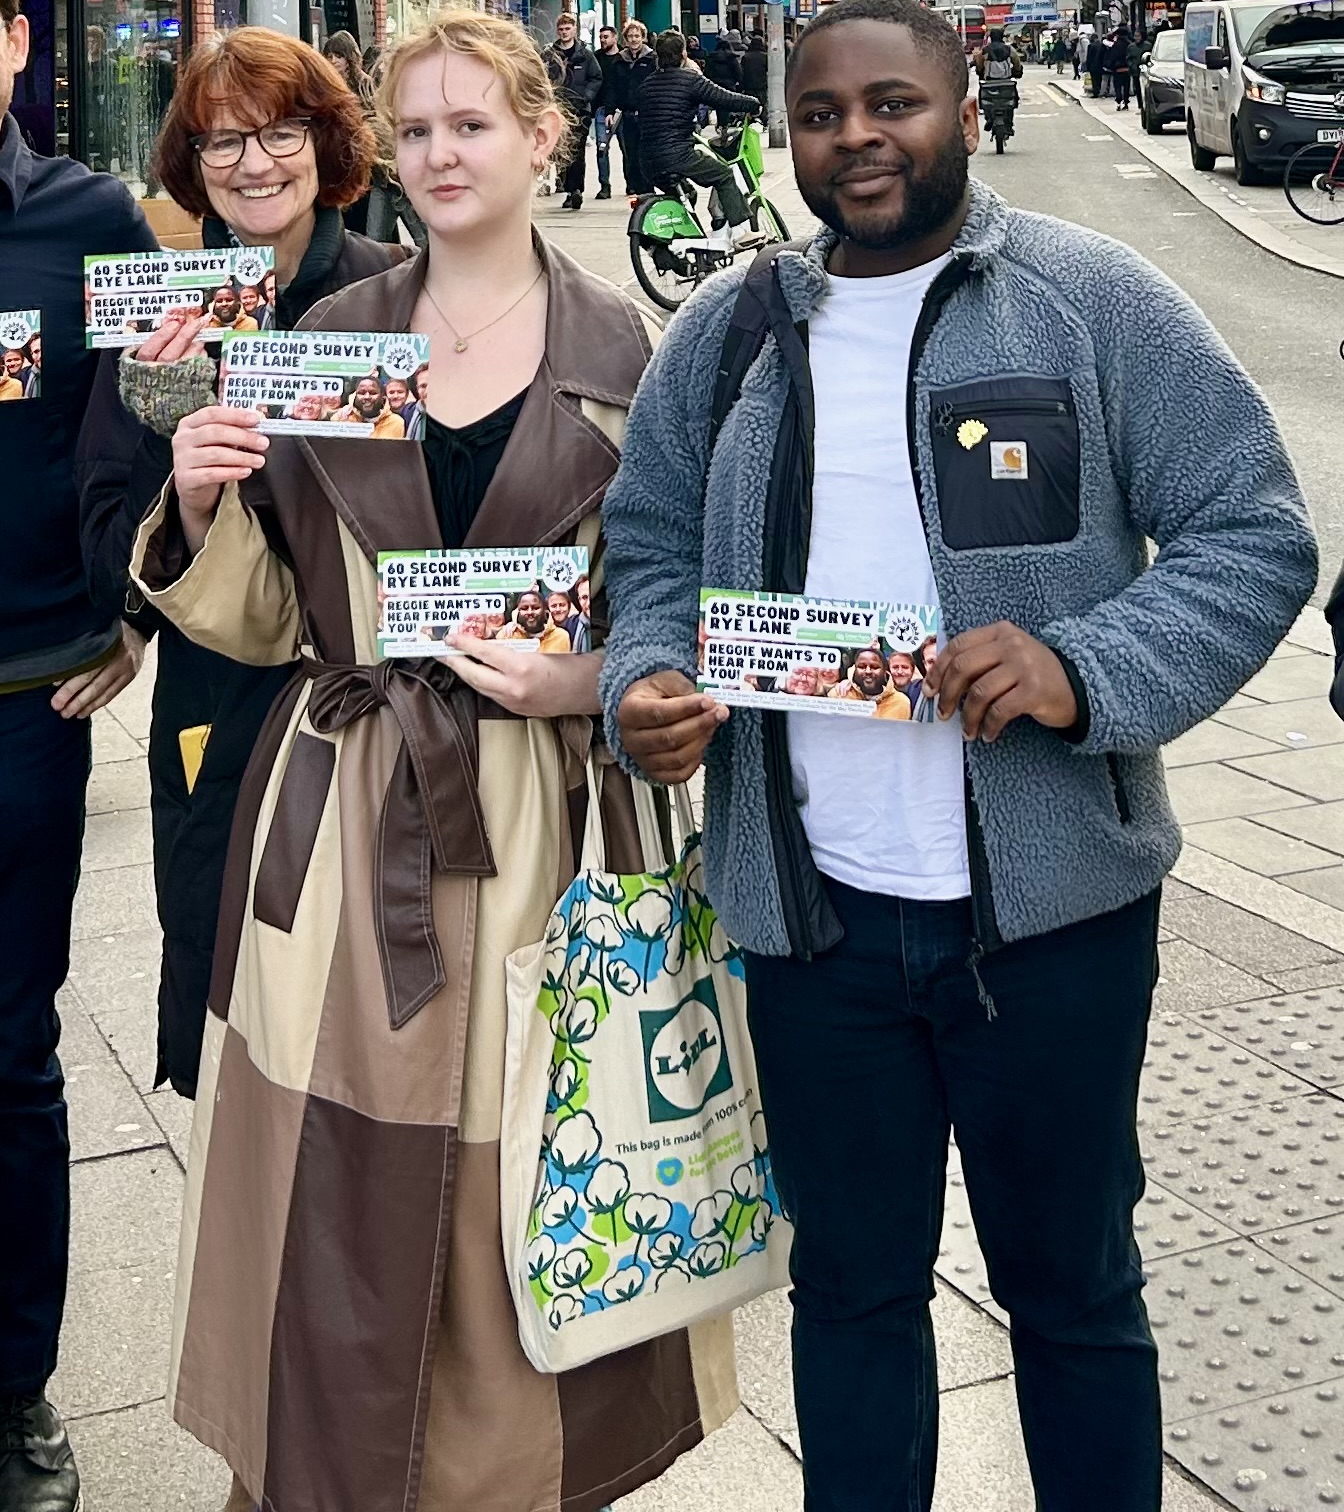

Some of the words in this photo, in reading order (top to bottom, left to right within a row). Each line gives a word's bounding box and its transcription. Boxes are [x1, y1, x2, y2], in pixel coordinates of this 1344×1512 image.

[94, 265, 110, 276] 60
[115, 261, 169, 275] SECOND
[174, 258, 226, 272] SURVEY
[94, 276, 122, 288] RYE
[128, 274, 164, 286] LANE
[94, 297, 134, 308] REGGIE
[139, 295, 182, 305] WANTS
[186, 293, 200, 302] TO
[95, 308, 125, 317] HEAR
[130, 306, 163, 316] FROM
[95, 318, 123, 328] YOU!
[232, 341, 248, 353] 60
[252, 342, 308, 355] SECOND
[313, 344, 374, 358] SURVEY
[230, 354, 257, 366] RYE
[262, 355, 300, 368] LANE
[228, 378, 267, 388] REGGIE
[272, 378, 318, 391] WANTS
[323, 381, 340, 391] TO
[227, 388, 257, 399] HEAR
[261, 390, 296, 401] FROM
[227, 399, 253, 409] YOU!
[387, 562, 405, 574] 60
[410, 560, 467, 574] SECOND
[472, 559, 532, 573] SURVEY
[387, 576, 417, 589] RYE
[423, 575, 461, 588] LANE
[387, 600, 429, 611] REGGIE
[434, 598, 481, 610] WANTS
[485, 598, 502, 609] TO
[387, 611, 420, 622] HEAR
[424, 609, 460, 620] FROM
[710, 602, 730, 615] 60
[735, 603, 800, 621] SECOND
[806, 609, 874, 627] SURVEY
[387, 622, 417, 633] YOU!
[710, 617, 743, 631] RYE
[749, 620, 792, 635] LANE
[709, 643, 755, 657] REGGIE
[761, 646, 813, 663] WANTS
[818, 651, 837, 664] TO
[708, 656, 744, 669] HEAR
[749, 659, 789, 672] FROM
[708, 668, 740, 681] YOU!
[616, 1142, 637, 1156] This
[640, 1138, 660, 1152] bag
[662, 1136, 672, 1147] is
[673, 1130, 702, 1145] made
